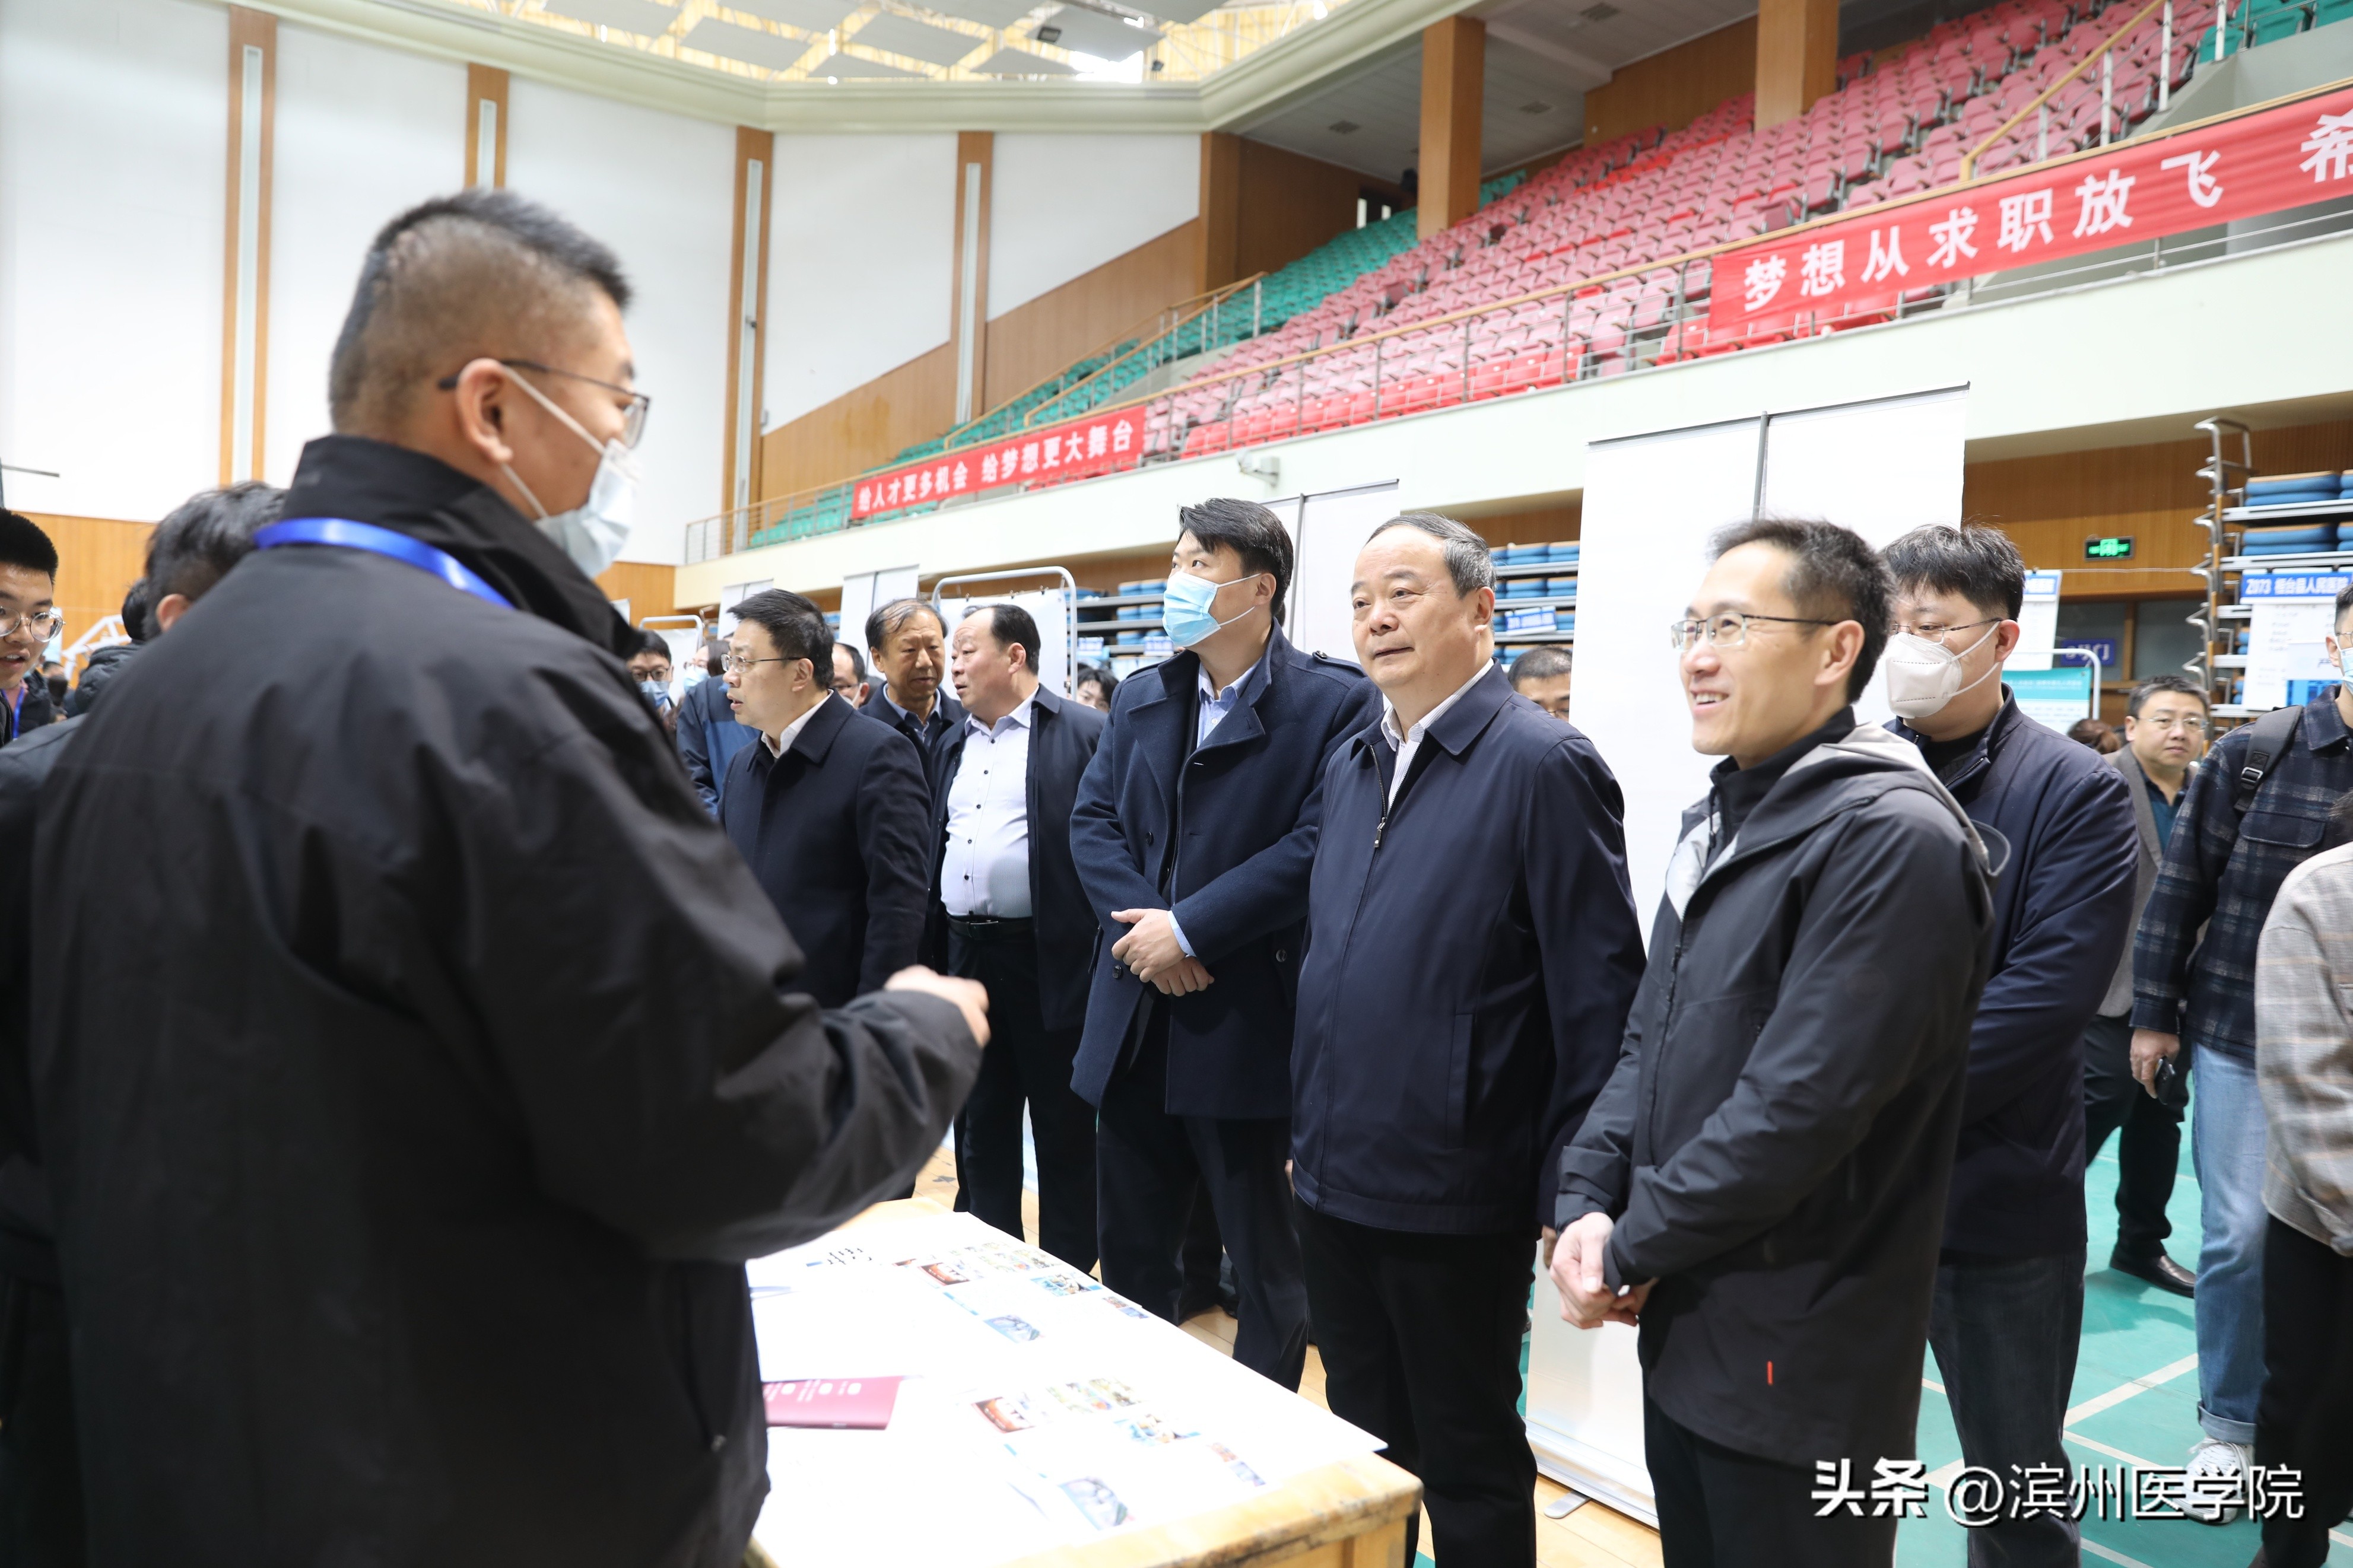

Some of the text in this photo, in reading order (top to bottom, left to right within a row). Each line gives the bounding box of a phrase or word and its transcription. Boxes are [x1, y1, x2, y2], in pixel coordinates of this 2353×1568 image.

[1744, 107, 2353, 312] 梦想从求职放飞 希
[858, 419, 1134, 512] 给人才更多机会 给梦想更大舞台
